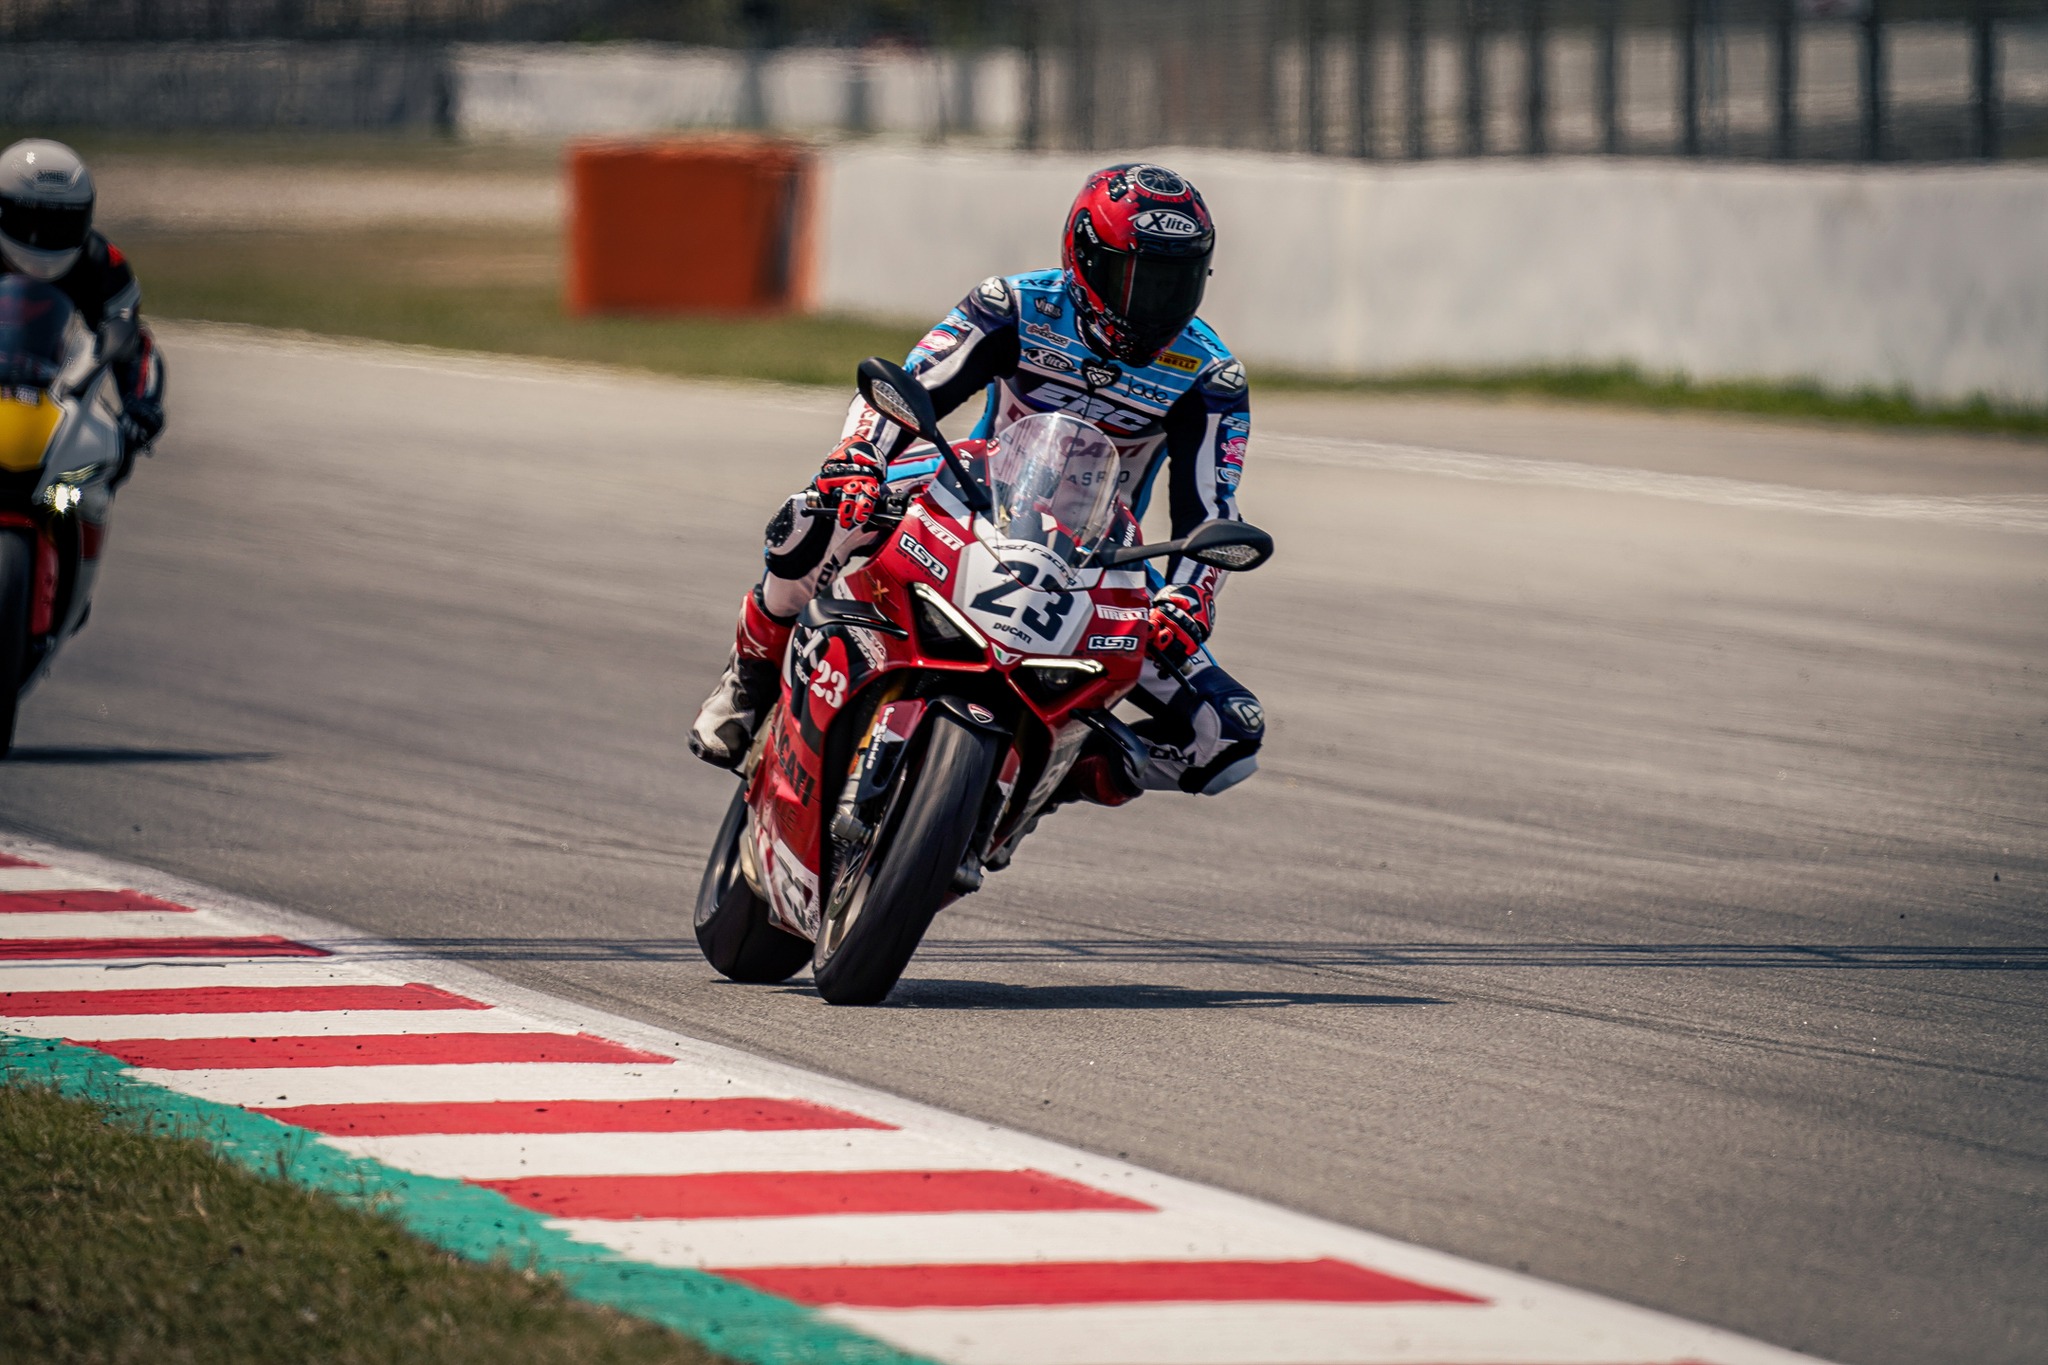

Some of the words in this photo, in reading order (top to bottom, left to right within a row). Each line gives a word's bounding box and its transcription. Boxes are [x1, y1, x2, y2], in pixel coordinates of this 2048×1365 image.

[1141, 213, 1193, 233] X-lite
[1031, 349, 1069, 370] X-lite
[1121, 375, 1168, 404] jade
[1026, 381, 1152, 432] ERC
[969, 560, 1075, 642] 23
[1095, 603, 1149, 622] PIRELLI
[993, 621, 1033, 645] DUCATI
[810, 659, 848, 709] 23
